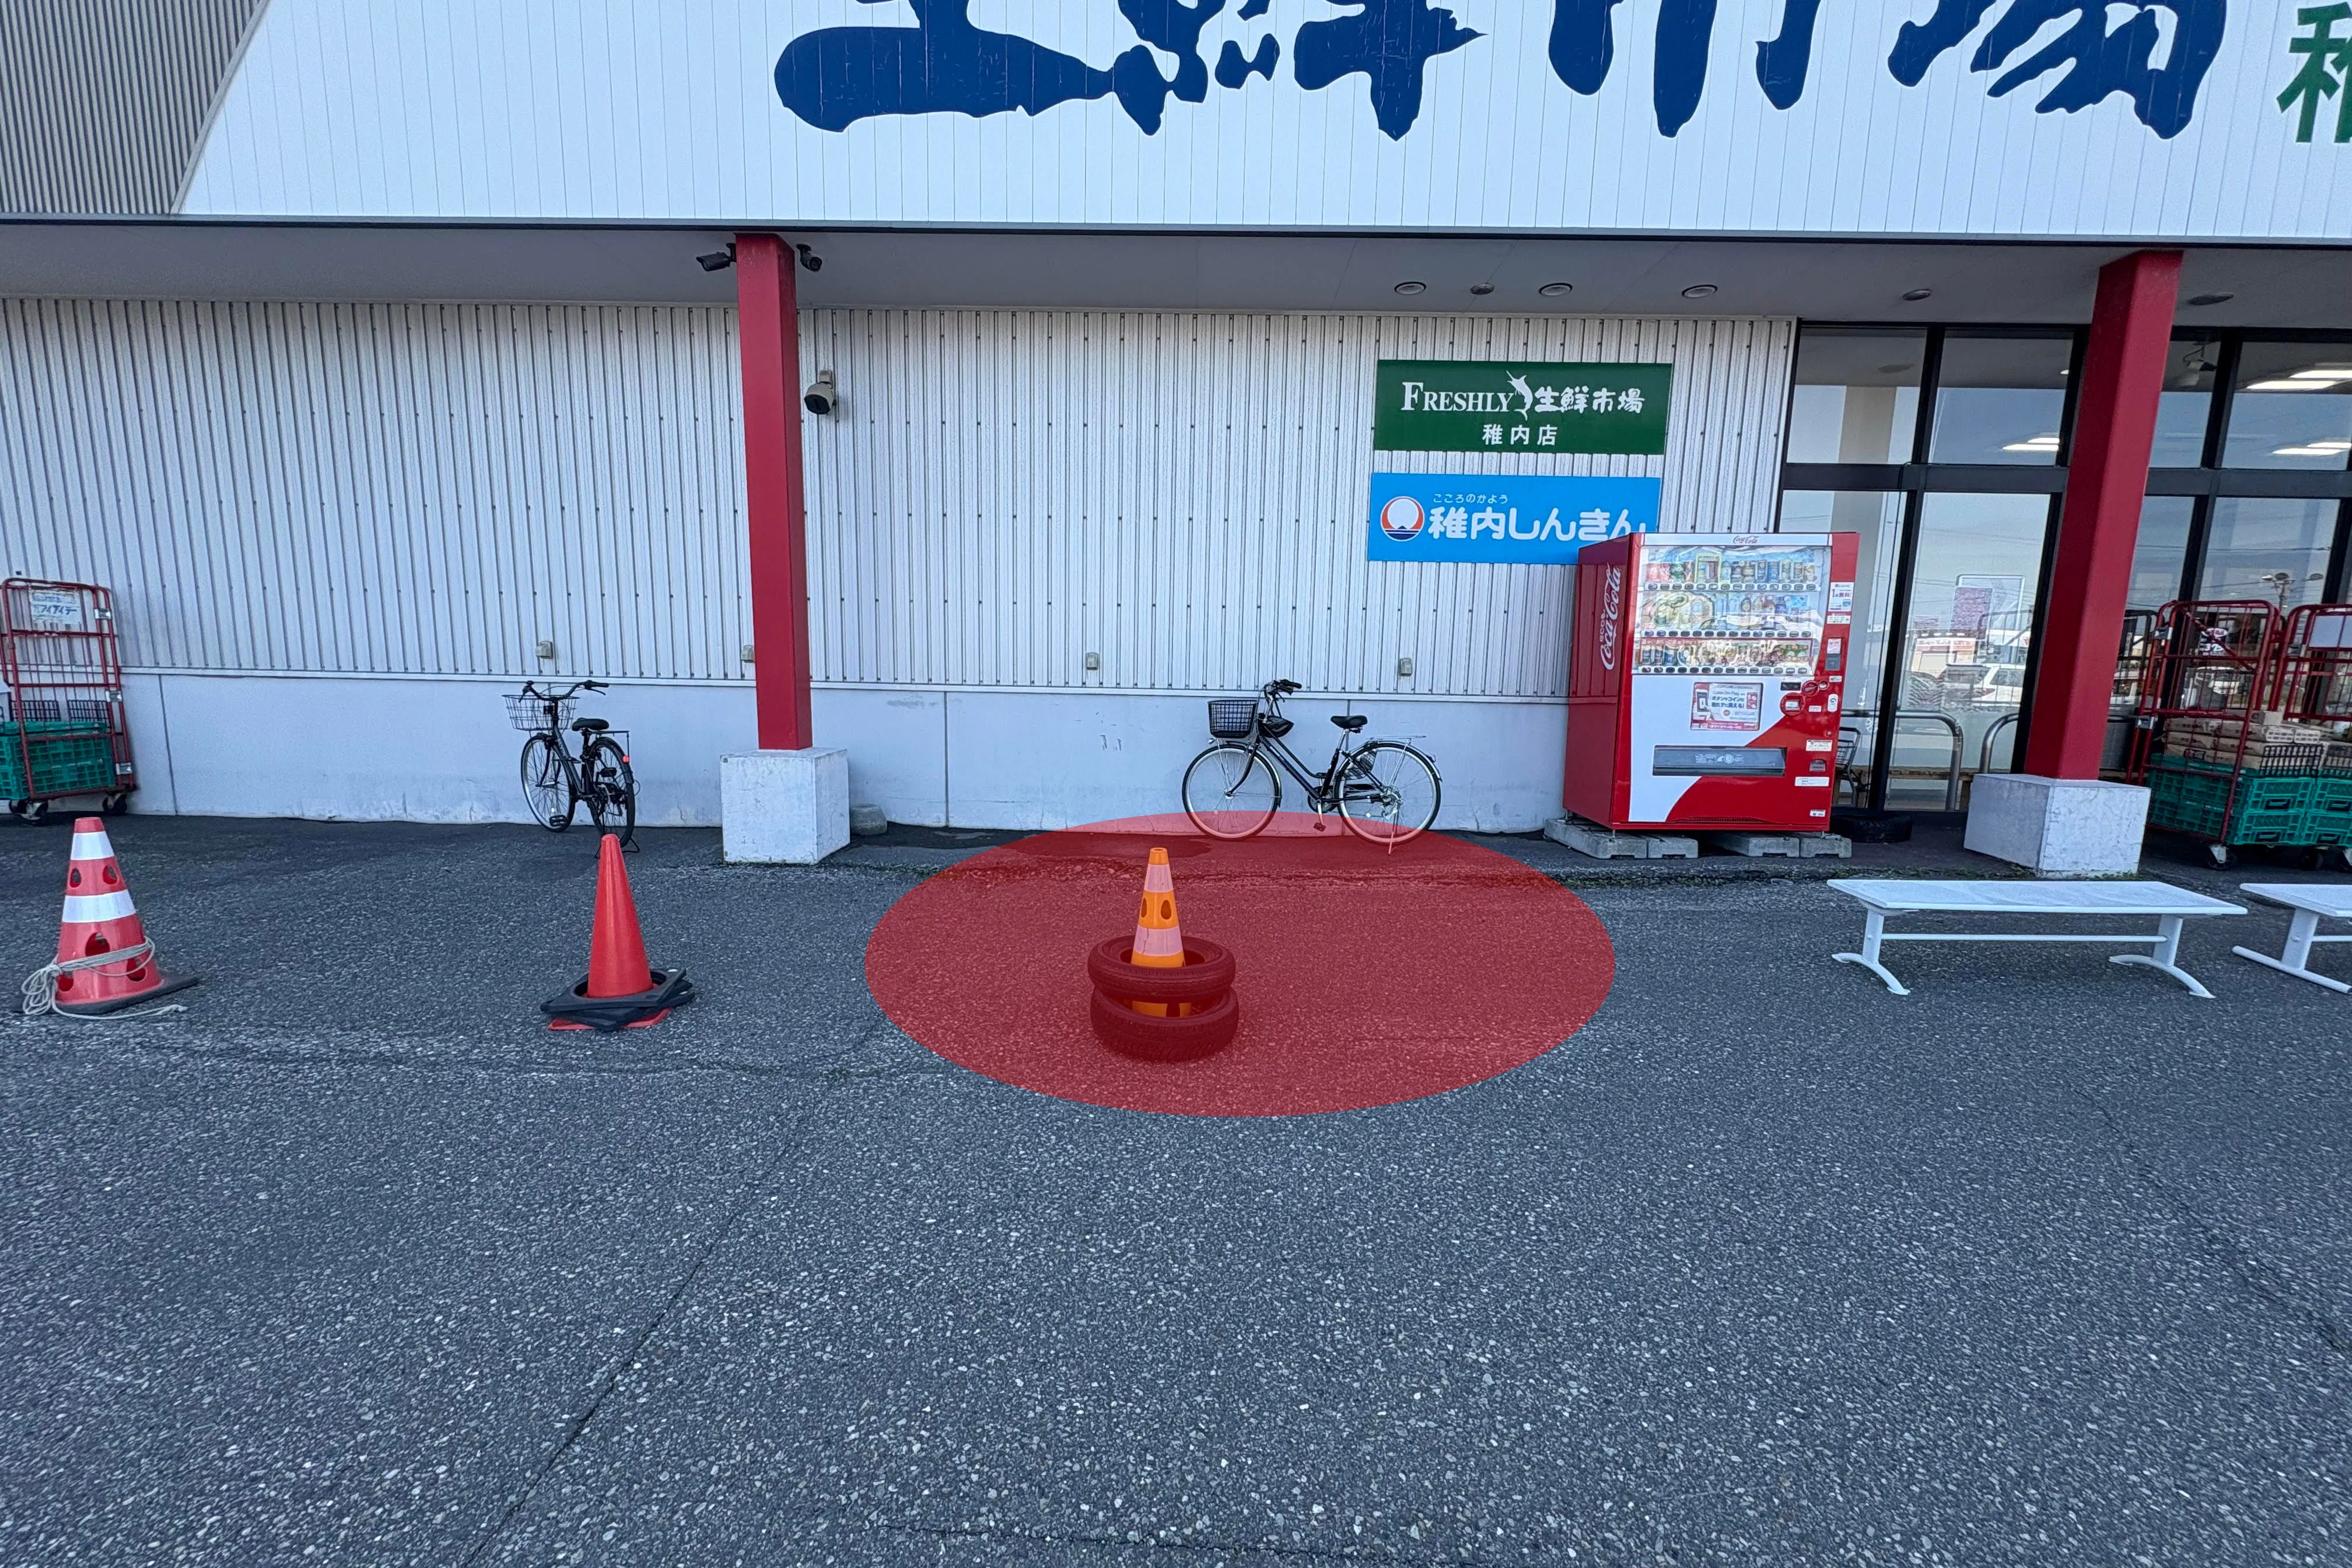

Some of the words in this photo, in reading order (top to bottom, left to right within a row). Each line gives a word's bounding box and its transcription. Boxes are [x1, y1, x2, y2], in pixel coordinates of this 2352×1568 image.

[1401, 382, 1514, 412] FRESHLY
[1534, 385, 1646, 414] 生鮮市場
[1482, 423, 1558, 446] 稚内店
[1433, 493, 1508, 505] こころのかよう
[1428, 506, 1647, 542] 稚内しんきん
[1600, 562, 1621, 670] Coca-Cola
